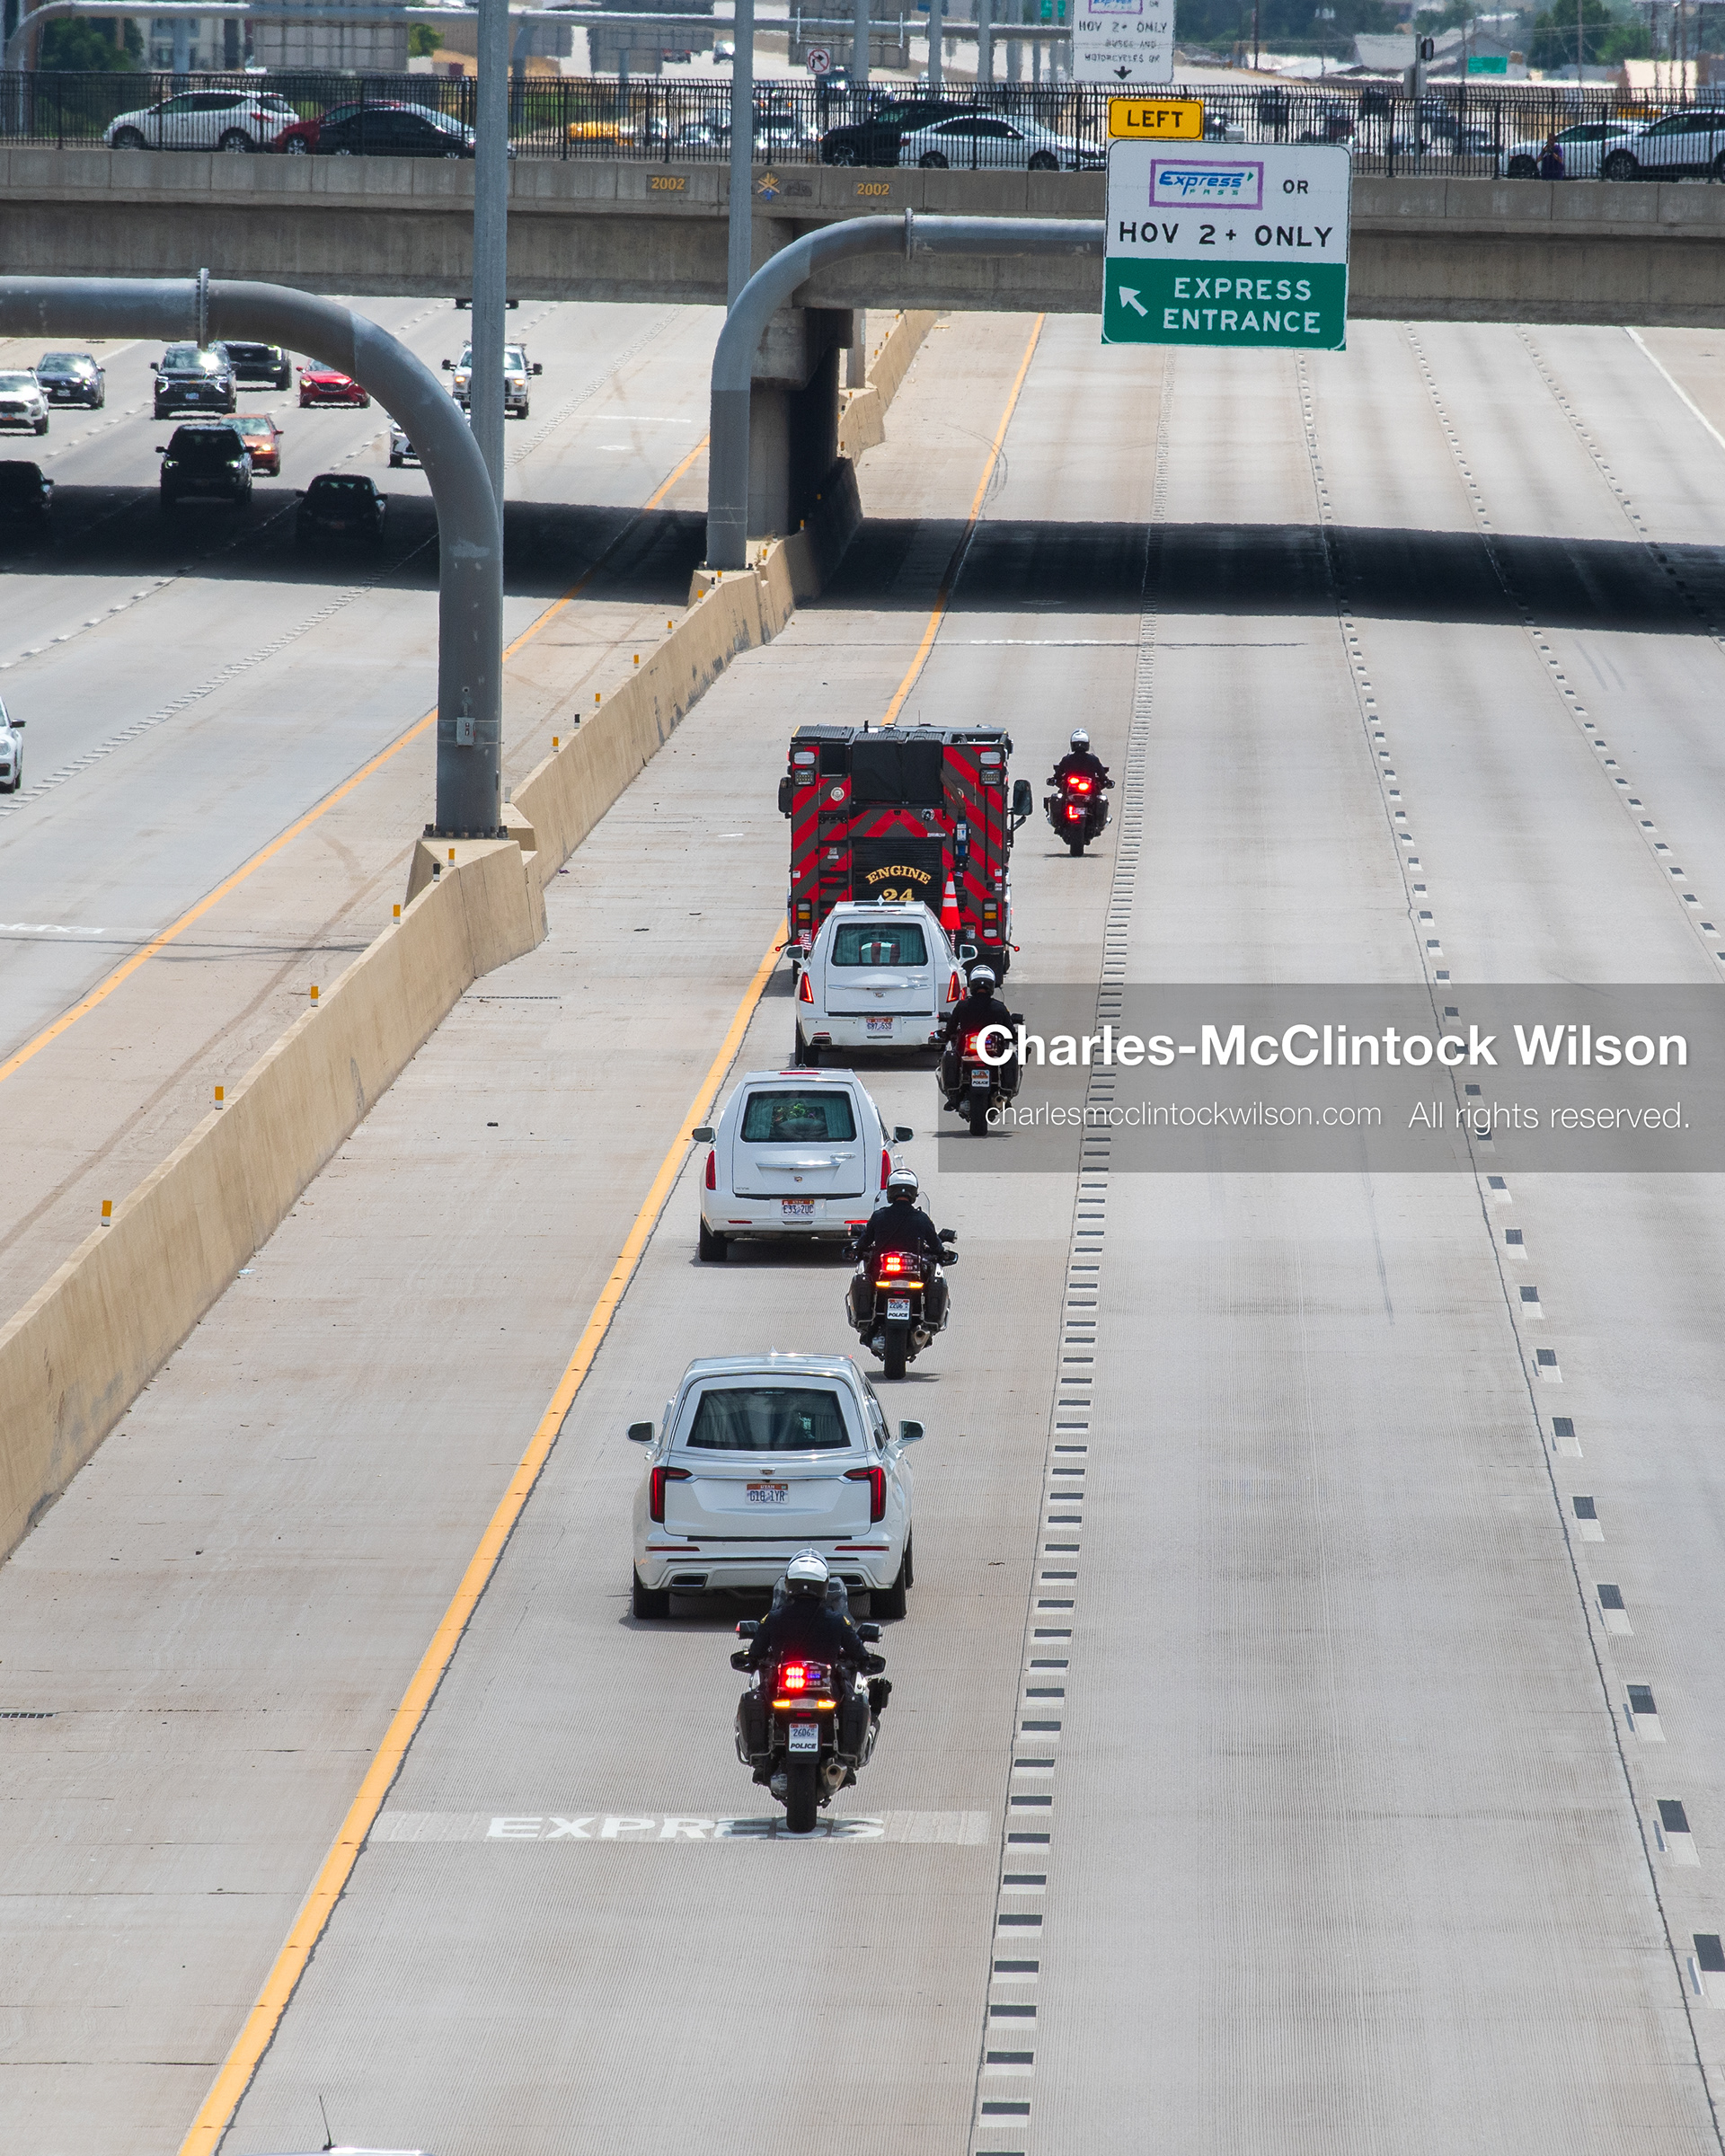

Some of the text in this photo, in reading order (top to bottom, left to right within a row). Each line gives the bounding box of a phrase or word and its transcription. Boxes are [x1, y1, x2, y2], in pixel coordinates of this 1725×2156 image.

[1078, 21, 1102, 31] HOV
[1136, 22, 1168, 33] ONLY
[1084, 54, 1145, 63] MOTORCYCLES
[1126, 109, 1183, 128] LEFT
[650, 176, 686, 191] 2002
[856, 182, 889, 197] 2002
[1158, 170, 1309, 196] Express OR
[1119, 221, 1180, 243] HOV
[1254, 225, 1334, 248] ONLY
[1173, 277, 1313, 302] EXPRESS
[1163, 307, 1322, 334] ENTRANCE
[864, 865, 932, 885] ENGINE
[882, 888, 916, 902] 24
